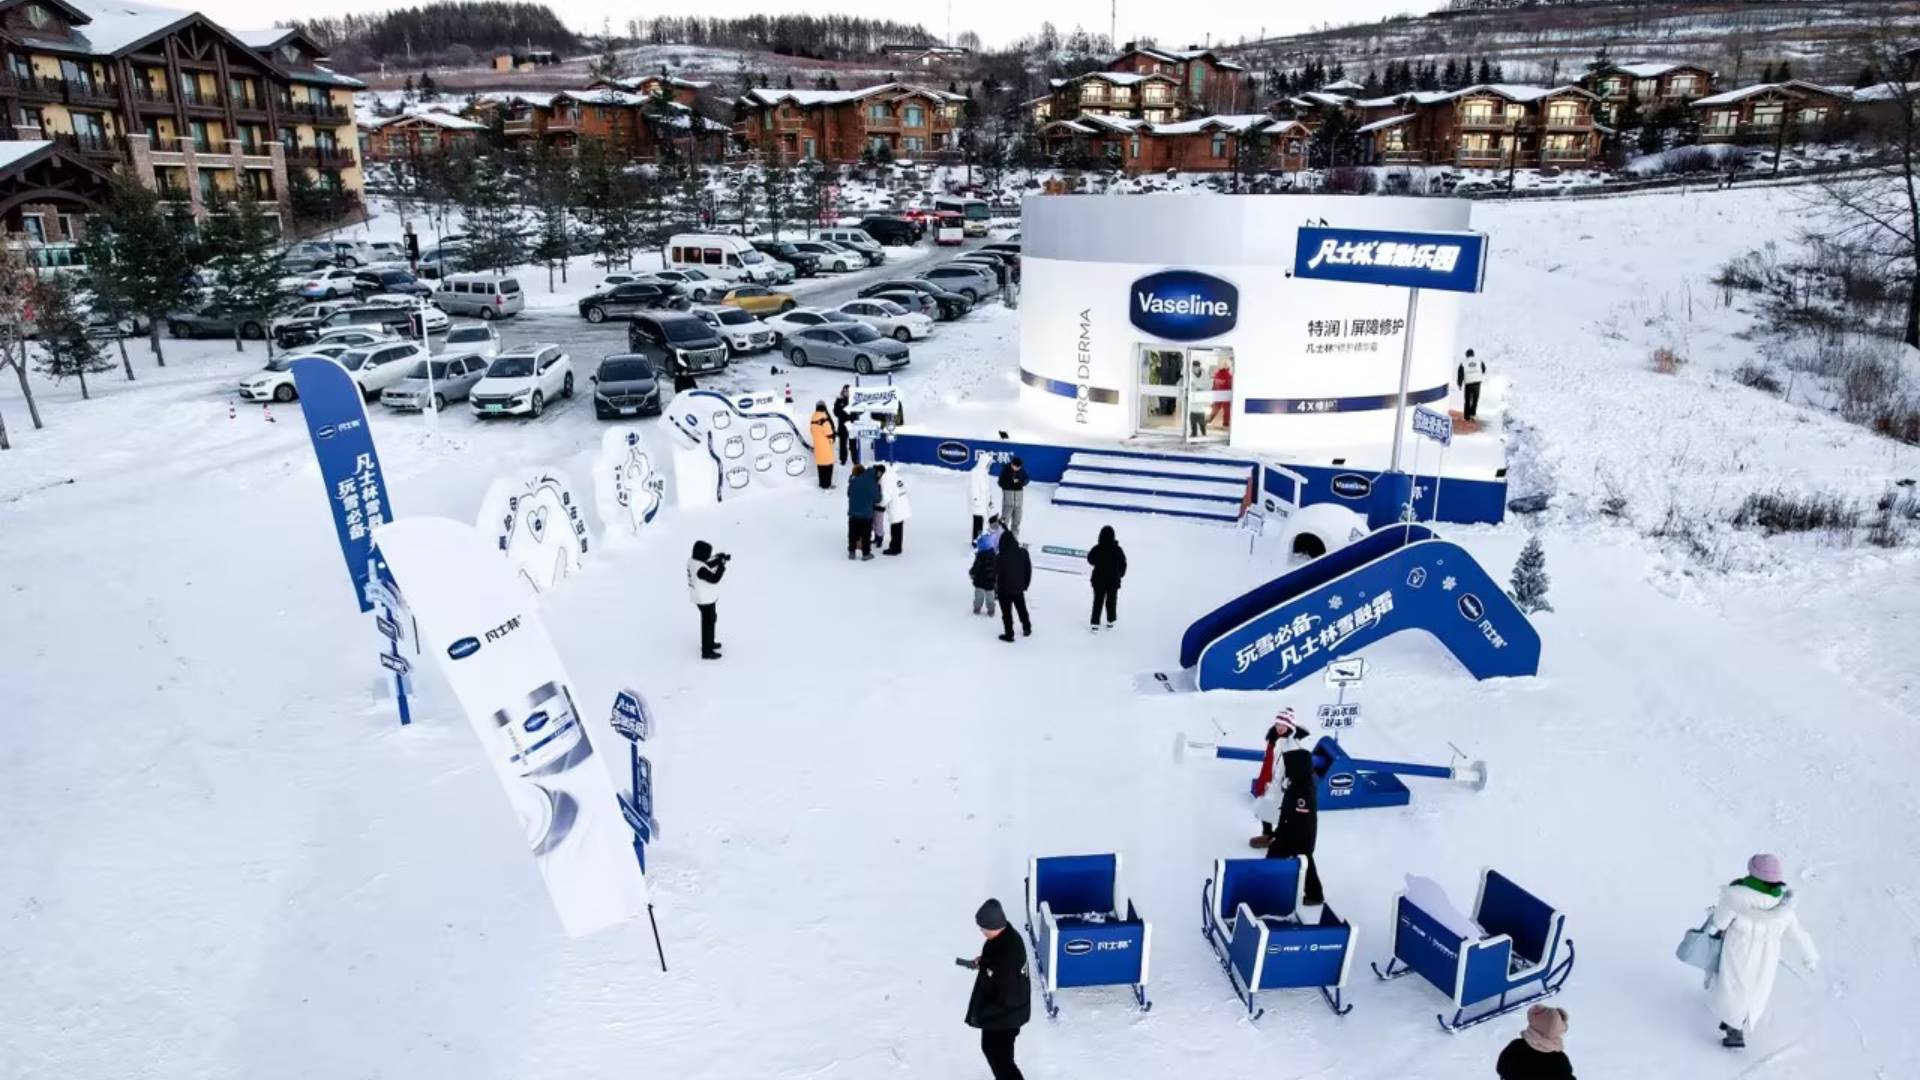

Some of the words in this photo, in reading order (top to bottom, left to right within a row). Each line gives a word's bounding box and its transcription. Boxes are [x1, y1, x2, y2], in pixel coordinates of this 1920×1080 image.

[1078, 308, 1091, 379] DERMA
[1076, 384, 1089, 424] PRO
[485, 614, 521, 642] 凡士林
[1233, 612, 1322, 674] 玩雪必备
[1478, 619, 1508, 649] 凡士林
